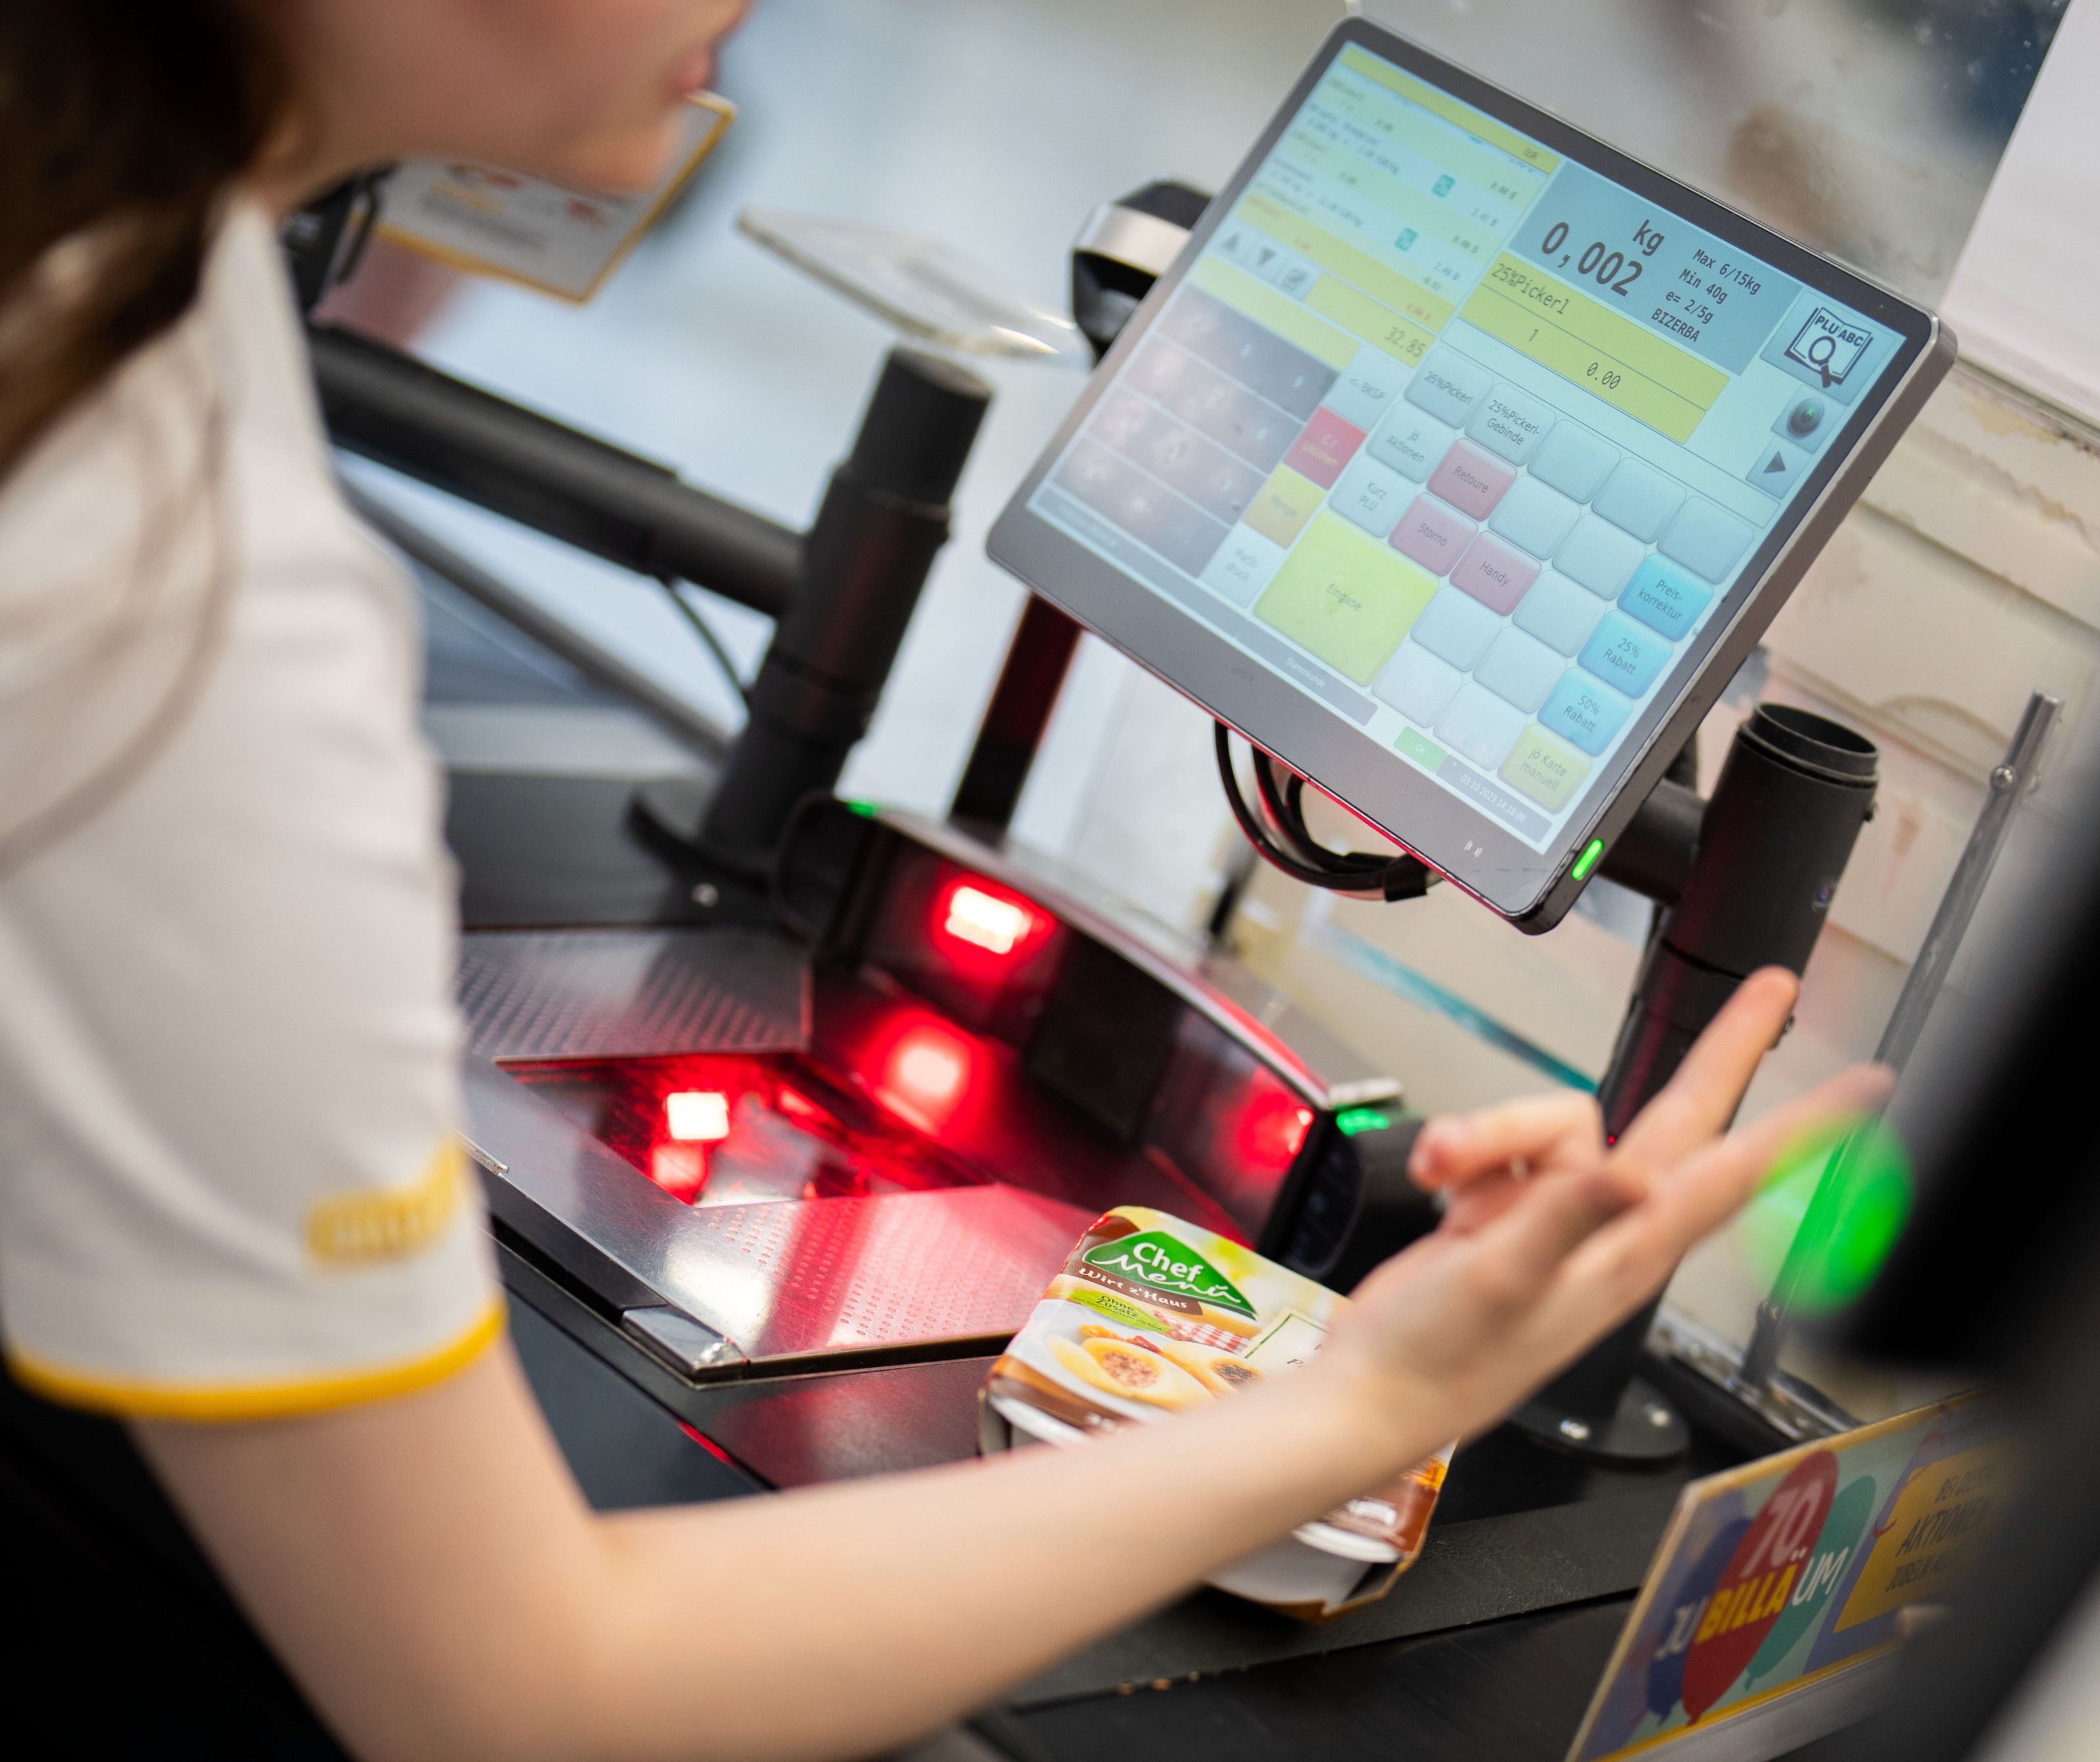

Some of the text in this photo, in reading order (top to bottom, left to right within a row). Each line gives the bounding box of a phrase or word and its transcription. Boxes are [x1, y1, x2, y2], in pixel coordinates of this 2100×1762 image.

[1632, 219, 1665, 257] kg
[1542, 222, 1643, 297] 0,002
[1692, 249, 1762, 295] Max 6/15kg
[1491, 262, 1570, 314] 25%Pickerl
[1678, 268, 1728, 304] Min 40g
[1666, 291, 1714, 324] e= 2/5g
[1651, 308, 1700, 343] BIZERBA
[1814, 315, 1864, 346] PLU ABC
[1384, 324, 1427, 358] 32.85
[1528, 329, 1622, 390] 1 0.00
[1423, 371, 1475, 406] 25%Pickerl
[1488, 399, 1540, 434] 25%Pickerl-
[1486, 417, 1524, 446] Gebinde
[1385, 435, 1425, 463] Aktionen
[1366, 481, 1388, 499] Kurz
[1452, 465, 1490, 493] Retoure
[1416, 522, 1448, 547] Storno
[1479, 561, 1511, 587] Handy
[1326, 583, 1362, 612] Eingabe
[1637, 588, 1683, 621] korrektur
[1655, 579, 1683, 601] Preis-
[1603, 648, 1637, 675] Rabatt
[1616, 638, 1642, 658] 25%
[1563, 705, 1597, 733] Rabatt
[1576, 695, 1601, 715] 50%
[1520, 762, 1560, 792] manuell
[1540, 754, 1567, 777] Karte
[1460, 774, 1498, 803] 03.10.2023
[1132, 1242, 1204, 1282] Chef
[1078, 1267, 1125, 1290] Wirt
[1095, 1298, 1139, 1318] Zusatz
[1101, 1295, 1135, 1312] Ohne
